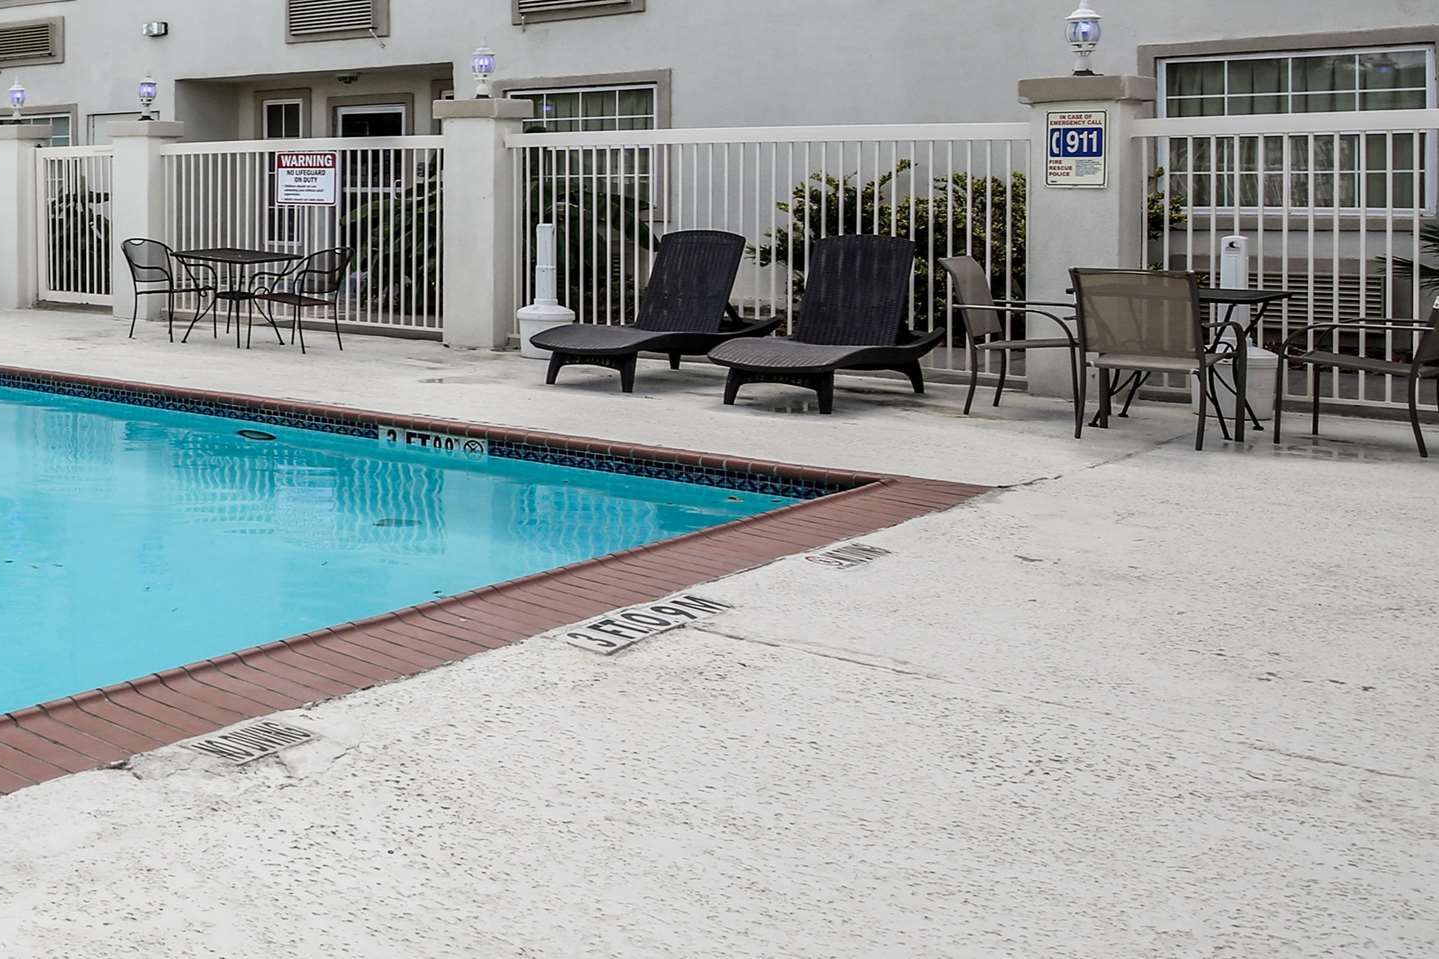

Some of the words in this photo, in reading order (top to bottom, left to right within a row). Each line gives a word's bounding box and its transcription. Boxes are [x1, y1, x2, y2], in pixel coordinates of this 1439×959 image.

[1066, 130, 1098, 153] 911
[280, 154, 333, 167] WARNING
[218, 721, 311, 753] DIVING
